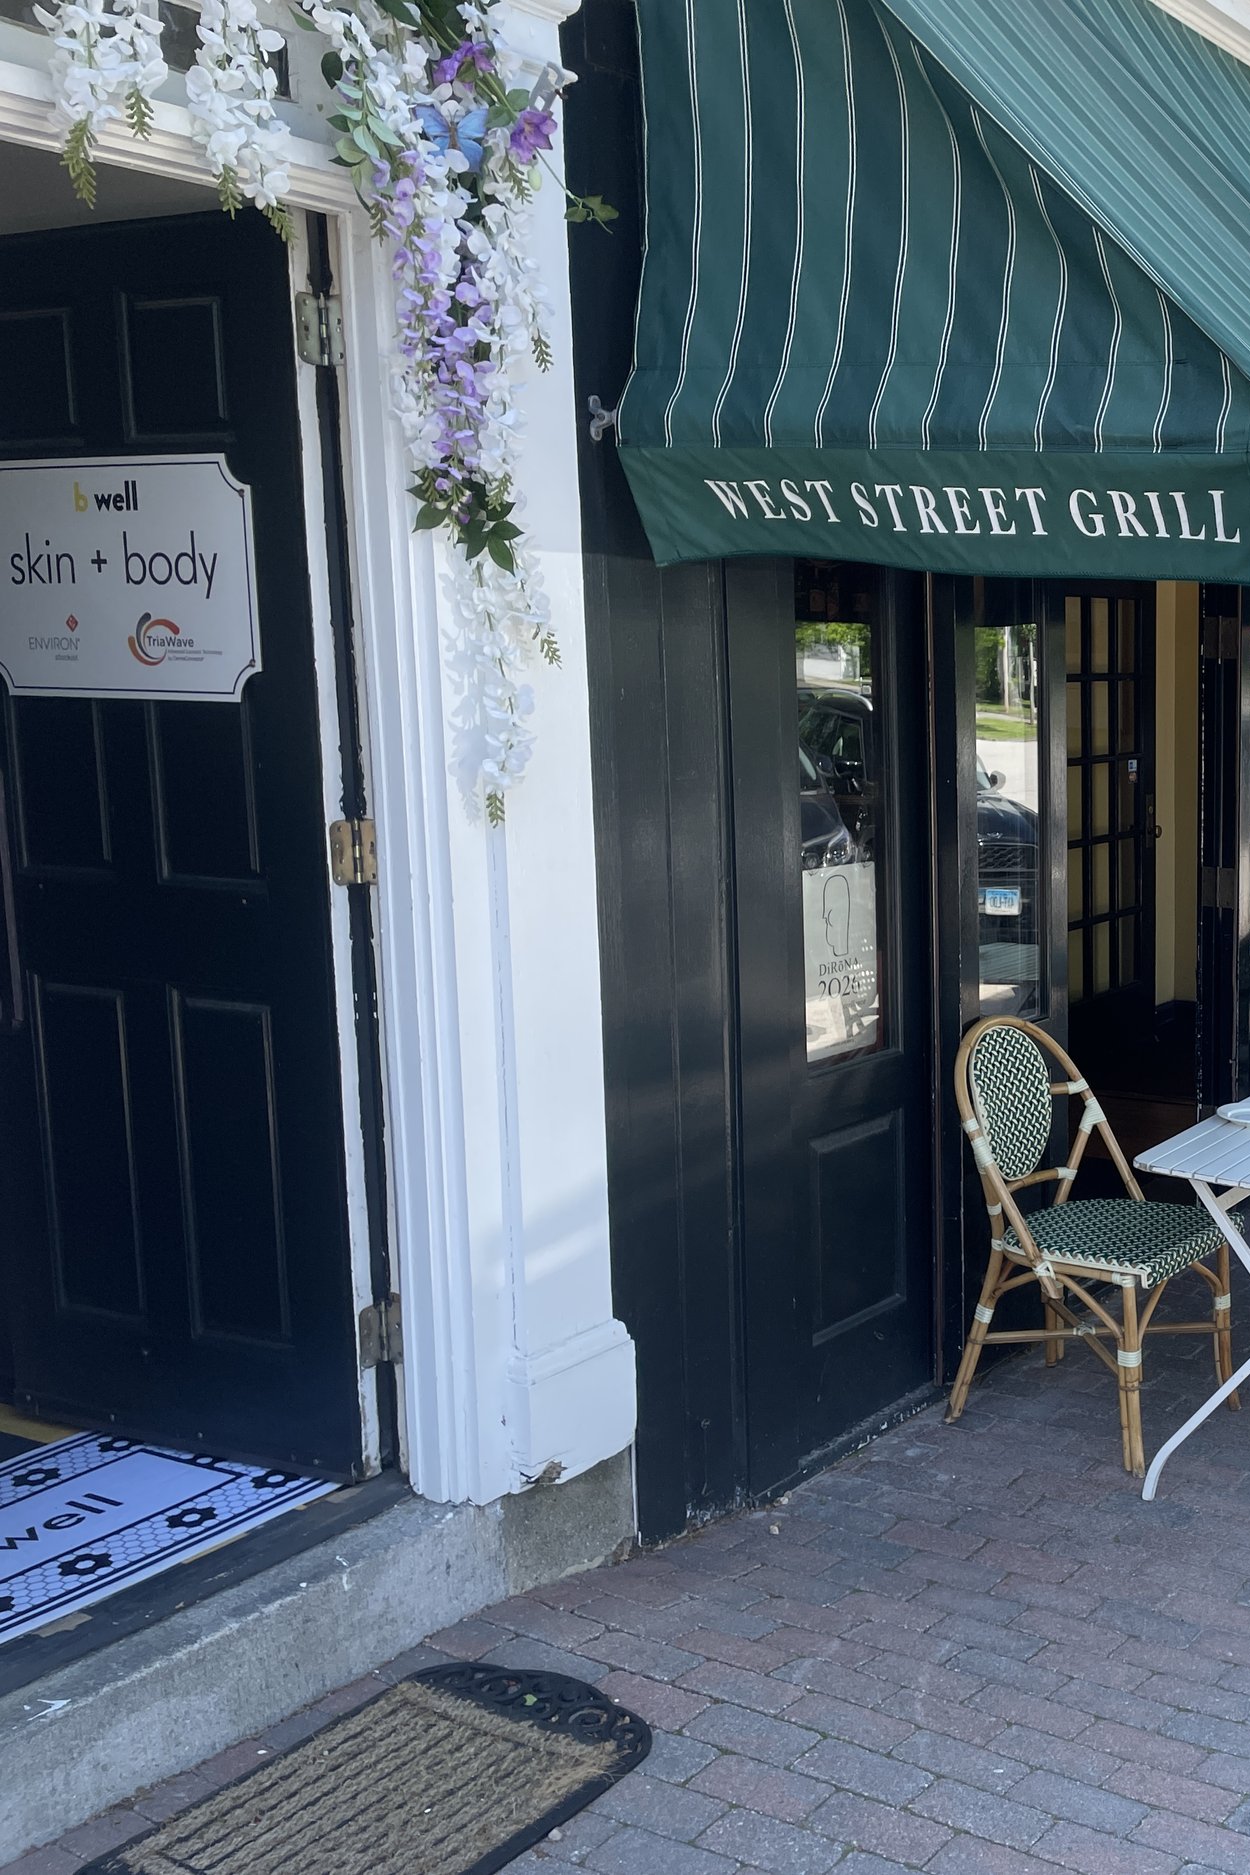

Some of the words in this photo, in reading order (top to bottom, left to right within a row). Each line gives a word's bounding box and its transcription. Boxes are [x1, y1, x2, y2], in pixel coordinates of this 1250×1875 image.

[73, 481, 89, 512] b
[94, 480, 139, 512] well
[704, 479, 841, 523] WEST
[850, 481, 1049, 536] STREET
[1069, 489, 1241, 544] GRILL
[10, 532, 76, 585] skin
[123, 530, 218, 599] body
[146, 635, 194, 648] TriaWave
[0, 1493, 124, 1550] well
